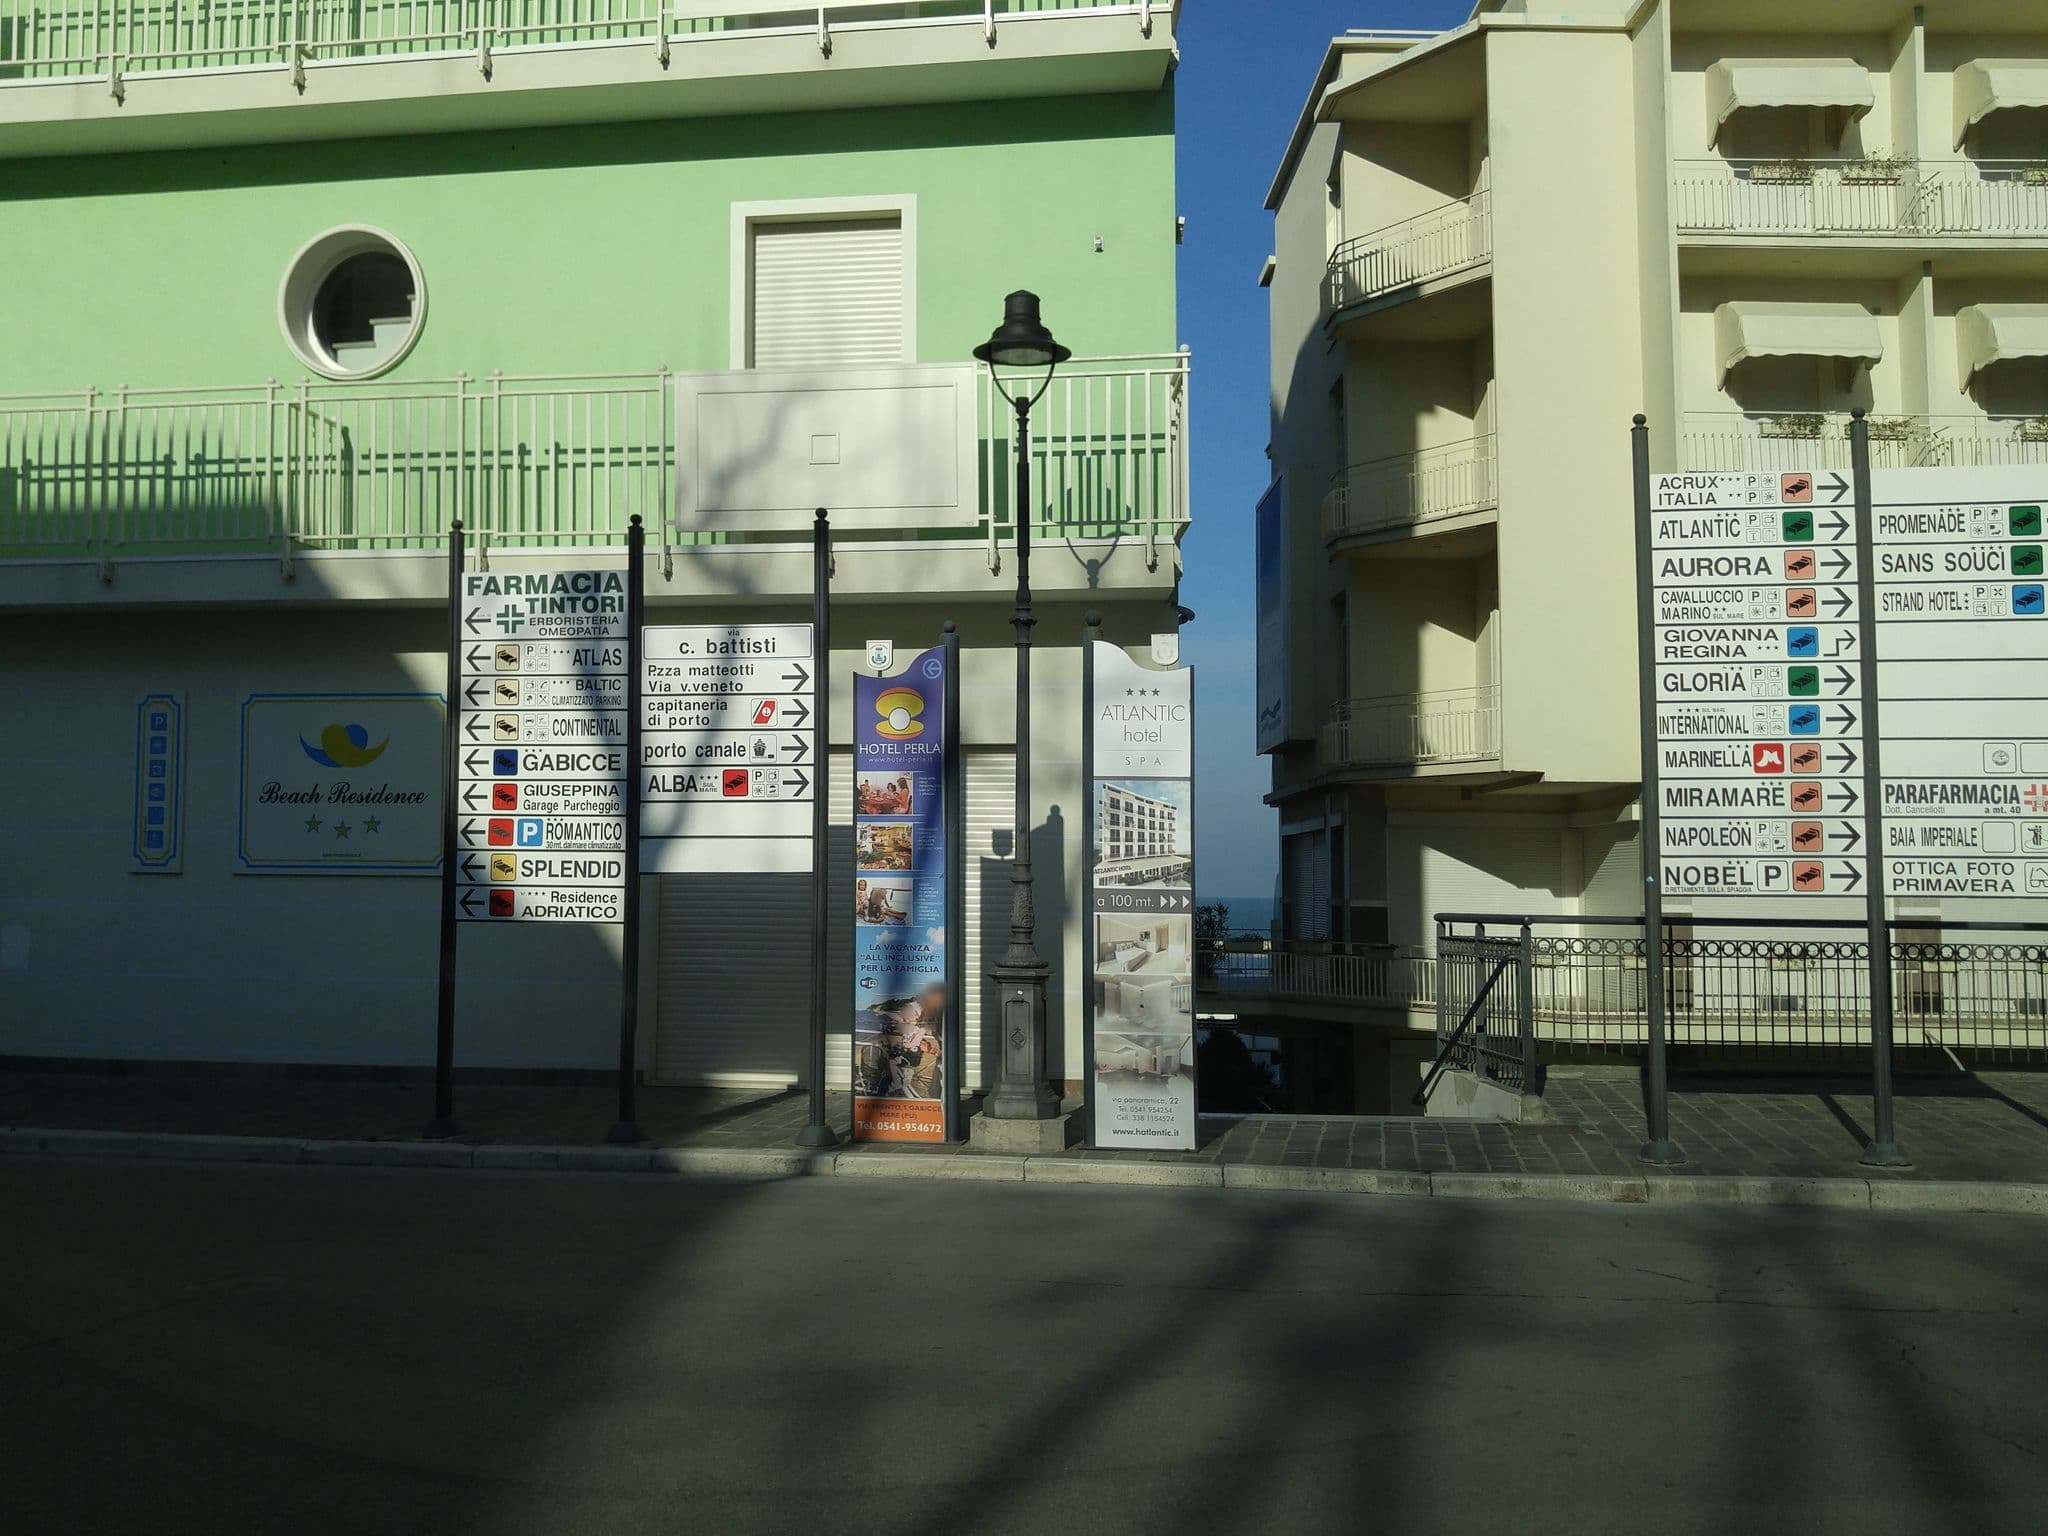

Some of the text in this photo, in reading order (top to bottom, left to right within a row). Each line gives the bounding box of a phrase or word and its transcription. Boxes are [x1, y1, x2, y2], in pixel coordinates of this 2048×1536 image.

[1659, 476, 1718, 489] ACRUX
[1659, 493, 1717, 505] ITALIA
[1659, 519, 1740, 539] ATLANTIC
[1880, 513, 1966, 534] PROMENADE
[1660, 556, 1772, 577] AURORA
[1882, 551, 2005, 573] SANS SOUCI
[467, 573, 623, 596] FARMACIA
[526, 596, 624, 613] TINTORI
[1661, 590, 1743, 604] CAVALLUCCIO
[1882, 592, 1924, 612] STRAND
[1929, 592, 1962, 611] HOTEL
[529, 616, 619, 626] ERBORISTERIA
[1661, 607, 1710, 620] MARINO
[539, 627, 609, 636] OMEOPATIA
[1664, 629, 1778, 642] GIOVANNA
[679, 638, 776, 654] c. battisti
[1664, 645, 1747, 658] REGINA
[572, 648, 622, 666] ATLAS
[689, 664, 754, 676] matteotti
[576, 680, 621, 691] BALTIC
[648, 681, 743, 692] Via v.veneto
[1663, 673, 1746, 692] GLORIA
[552, 696, 622, 705] CLIMATIZZATO PARKING
[648, 700, 728, 713] capitaneria
[648, 714, 710, 728] di porto
[1101, 705, 1185, 721] ATLANTIC
[552, 718, 621, 736] CONTINENTAL
[1659, 715, 1749, 735] INTERNATIONAL
[1124, 725, 1162, 742] hotel
[644, 742, 746, 762] porto canale
[859, 743, 941, 754] HOTEL PERLA
[523, 754, 621, 771] GABICCE
[1666, 749, 1751, 768] MARINELLA
[524, 785, 619, 797] GIUSEPPINA
[648, 775, 699, 792] ALBA
[258, 782, 428, 805] Beach Residence
[1666, 787, 1785, 807] MIRAMARE
[1885, 784, 2020, 804] PARAFARMACIA
[523, 800, 619, 813] Garage Parcheggio
[546, 822, 622, 840] ROMANTICO
[1666, 827, 1751, 847] NAPOLEON
[1890, 827, 1978, 847] BAIA IMPERIALE
[521, 860, 621, 878] SPLENDID
[1665, 865, 1753, 886] NOBEL
[1893, 862, 2015, 875] OTTICA FOTO
[1893, 879, 2015, 892] PRIMAVERA
[551, 891, 617, 903] Residence
[1097, 895, 1154, 907] a 100 mt.
[522, 906, 617, 918] ADRIATICO
[858, 1121, 942, 1133] Tel. 0541-954672
[1112, 1128, 1179, 1136] www.hatlantic.it
